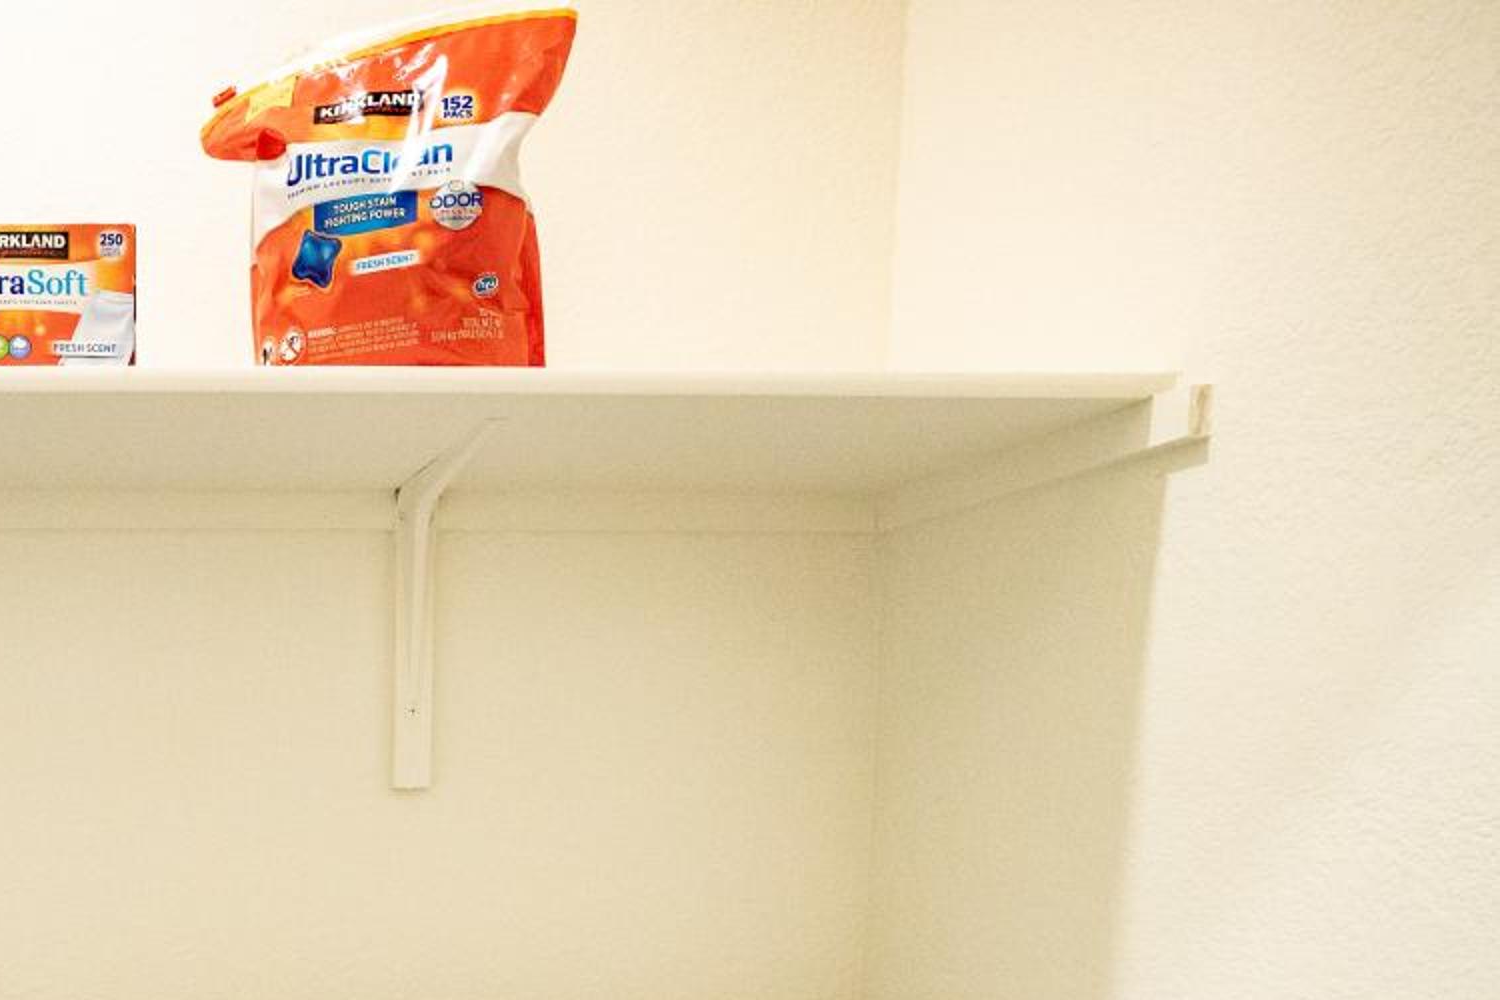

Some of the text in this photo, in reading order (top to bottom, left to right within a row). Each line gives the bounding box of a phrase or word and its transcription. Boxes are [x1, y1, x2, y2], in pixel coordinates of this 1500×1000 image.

[320, 93, 422, 118] KIRKLAND
[442, 96, 473, 109] 152
[333, 200, 367, 215] TOUGH
[429, 192, 484, 209] ODOR
[369, 208, 405, 220] POWER
[100, 233, 124, 247] 250
[53, 343, 84, 354] FRESH
